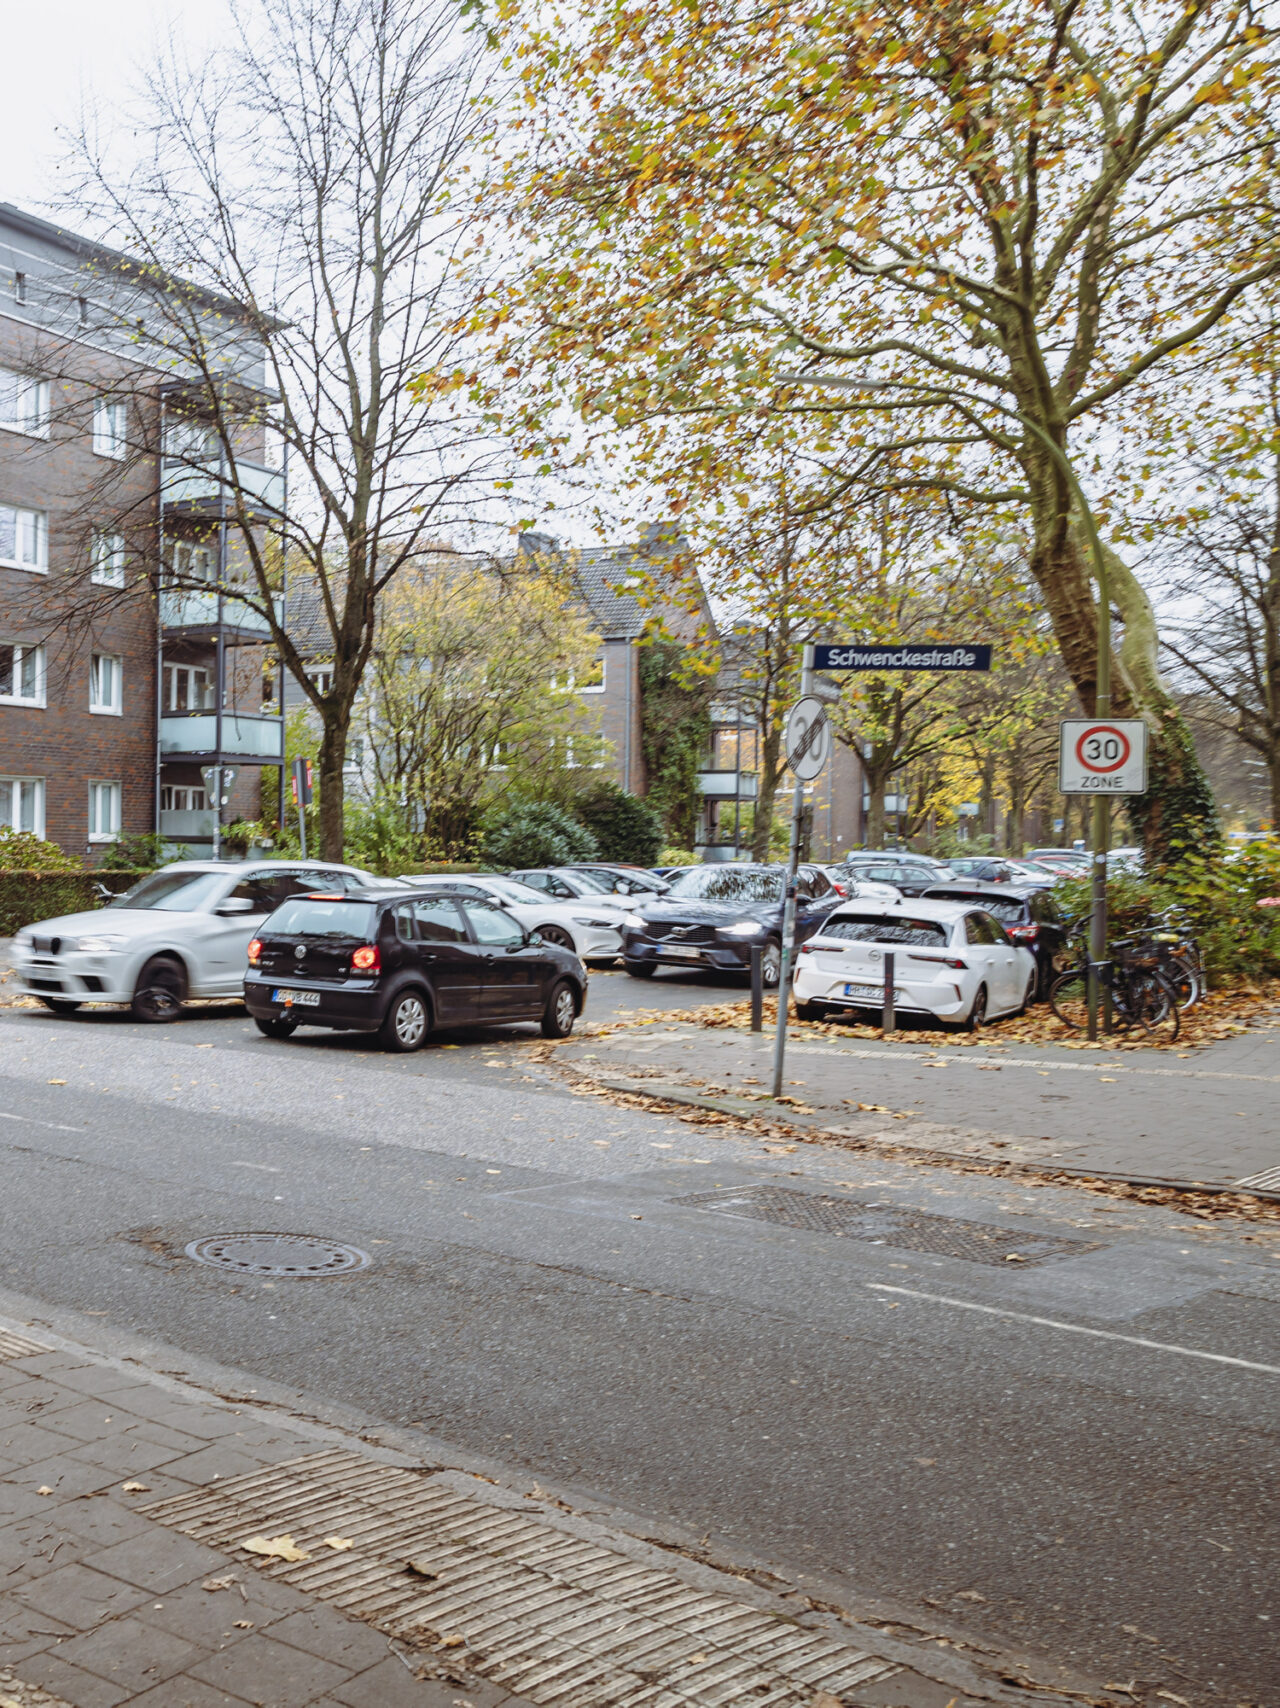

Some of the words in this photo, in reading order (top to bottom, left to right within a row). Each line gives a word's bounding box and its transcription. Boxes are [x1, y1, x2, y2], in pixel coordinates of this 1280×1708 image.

[827, 648, 977, 666] Schwenckestraße
[1086, 738, 1119, 760] 30
[1080, 776, 1125, 788] ZONE
